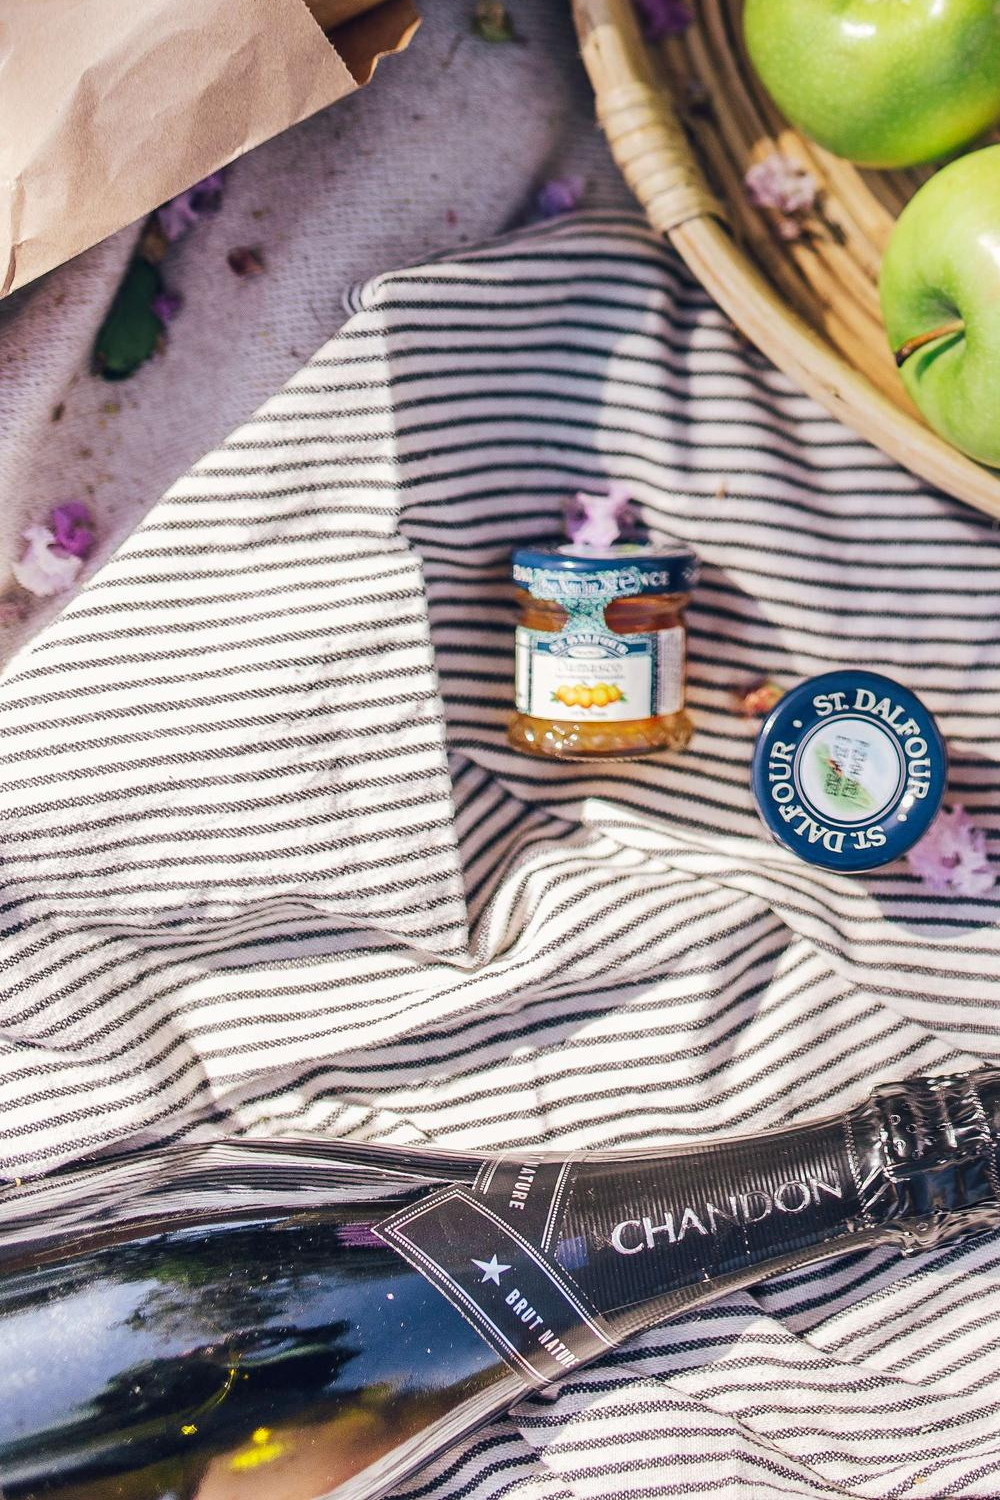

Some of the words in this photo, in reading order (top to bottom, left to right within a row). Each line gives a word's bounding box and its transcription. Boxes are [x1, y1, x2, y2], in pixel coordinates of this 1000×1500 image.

[812, 692, 850, 716] ST.
[852, 688, 932, 799] DALFOUR
[768, 740, 846, 853] DALFOUR
[850, 825, 887, 850] ST.
[611, 1176, 843, 1255] CHANDON
[505, 1288, 544, 1331] BRUT
